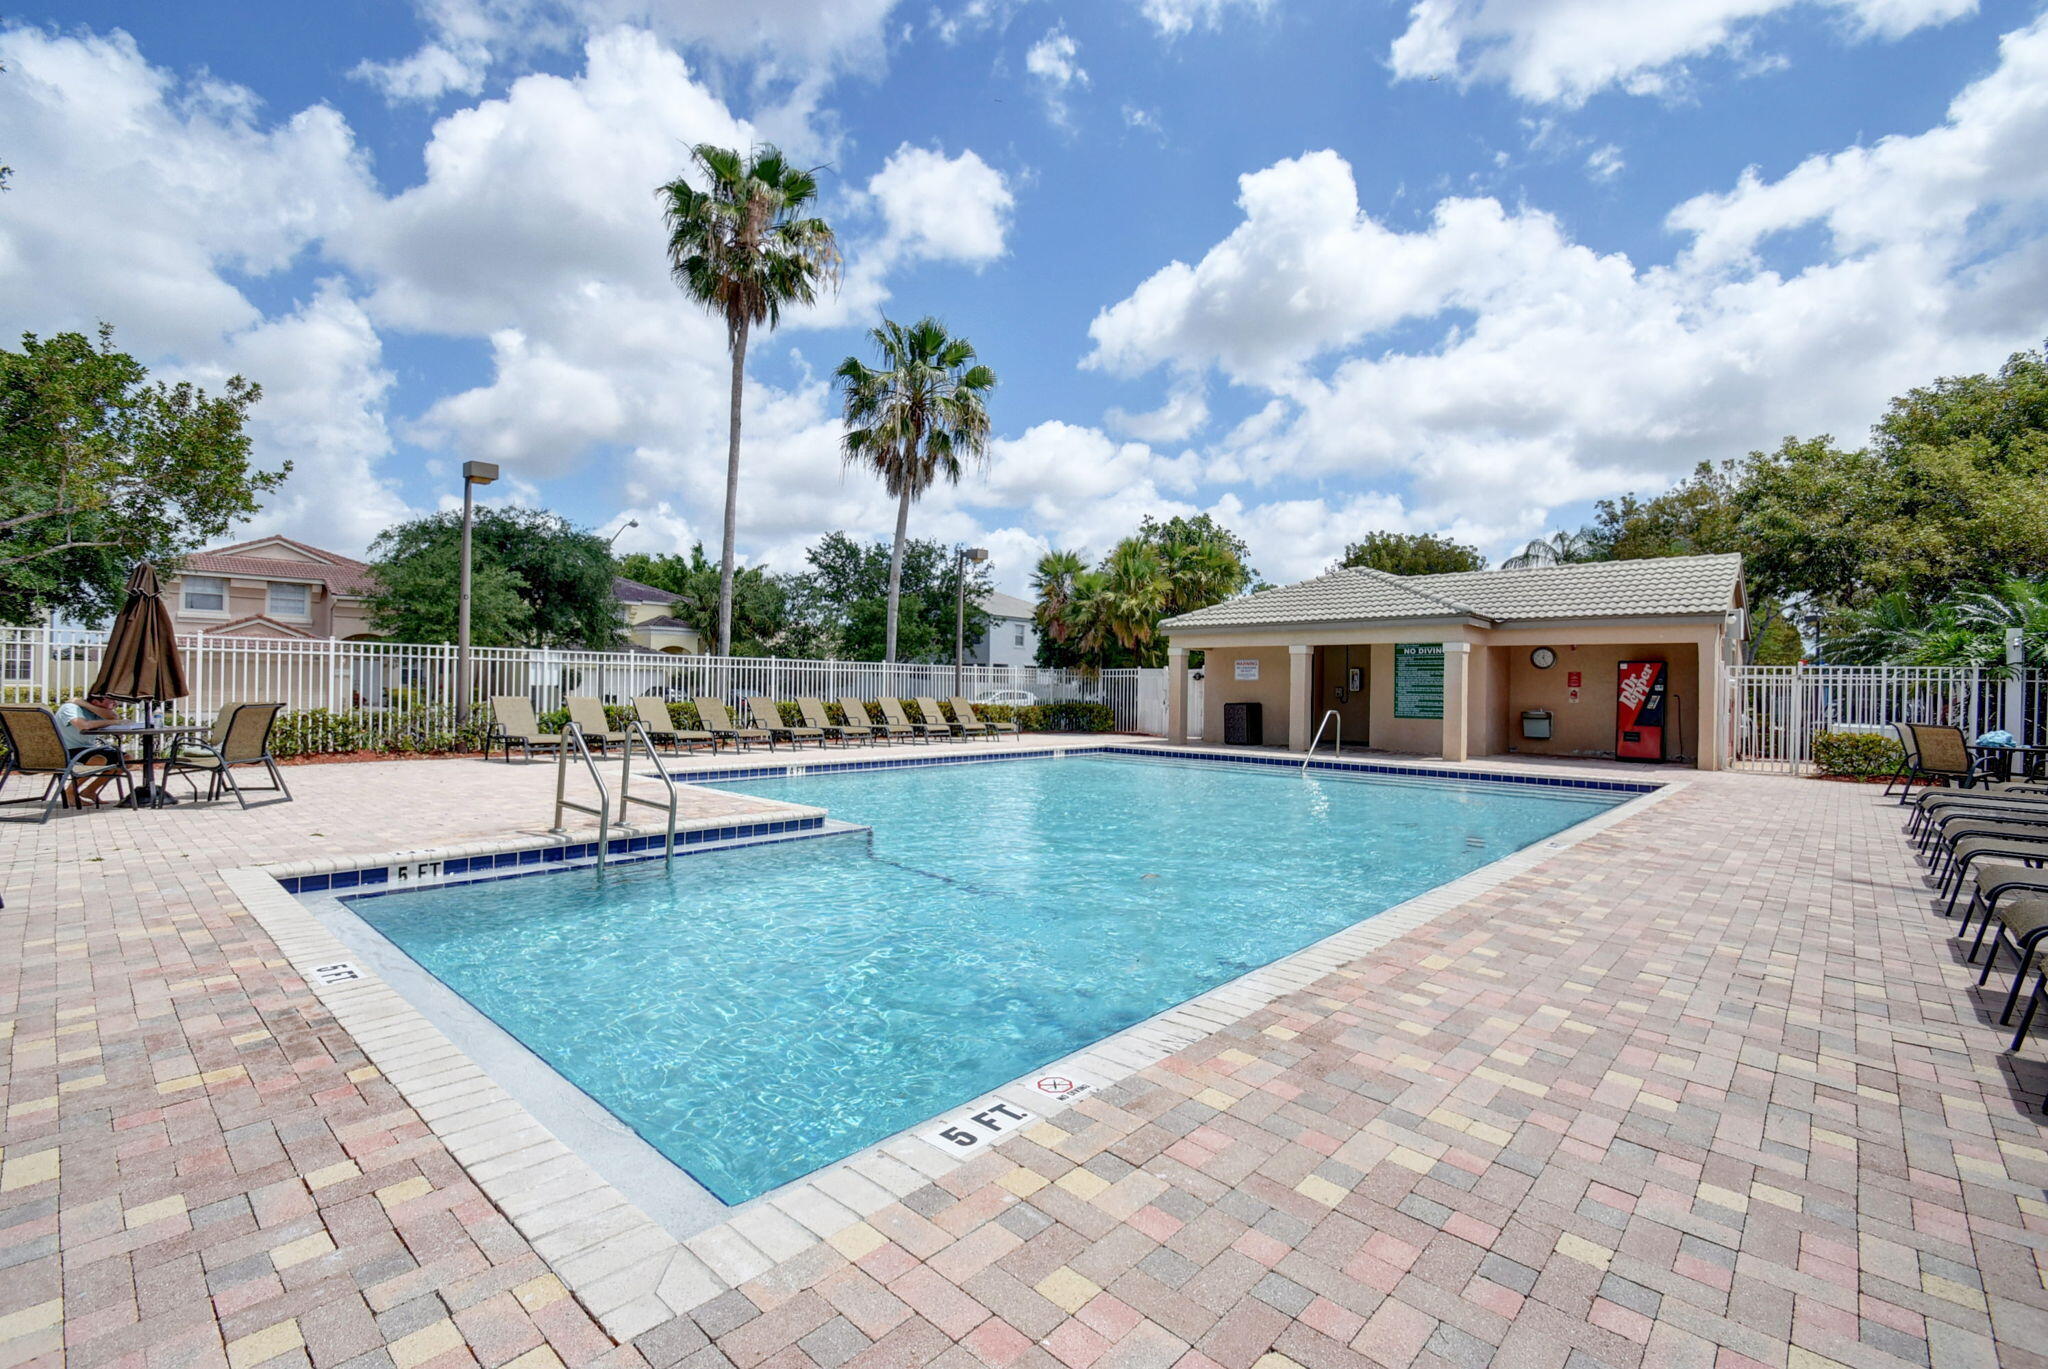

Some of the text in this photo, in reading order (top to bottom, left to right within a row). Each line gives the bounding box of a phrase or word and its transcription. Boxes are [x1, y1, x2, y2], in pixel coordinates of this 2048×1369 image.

[1619, 664, 1653, 710] Pepper
[1621, 674, 1638, 693] Dr
[398, 862, 441, 880] 5 FT
[1066, 1084, 1091, 1096] DIVING
[939, 1103, 1028, 1147] 5 FT.
